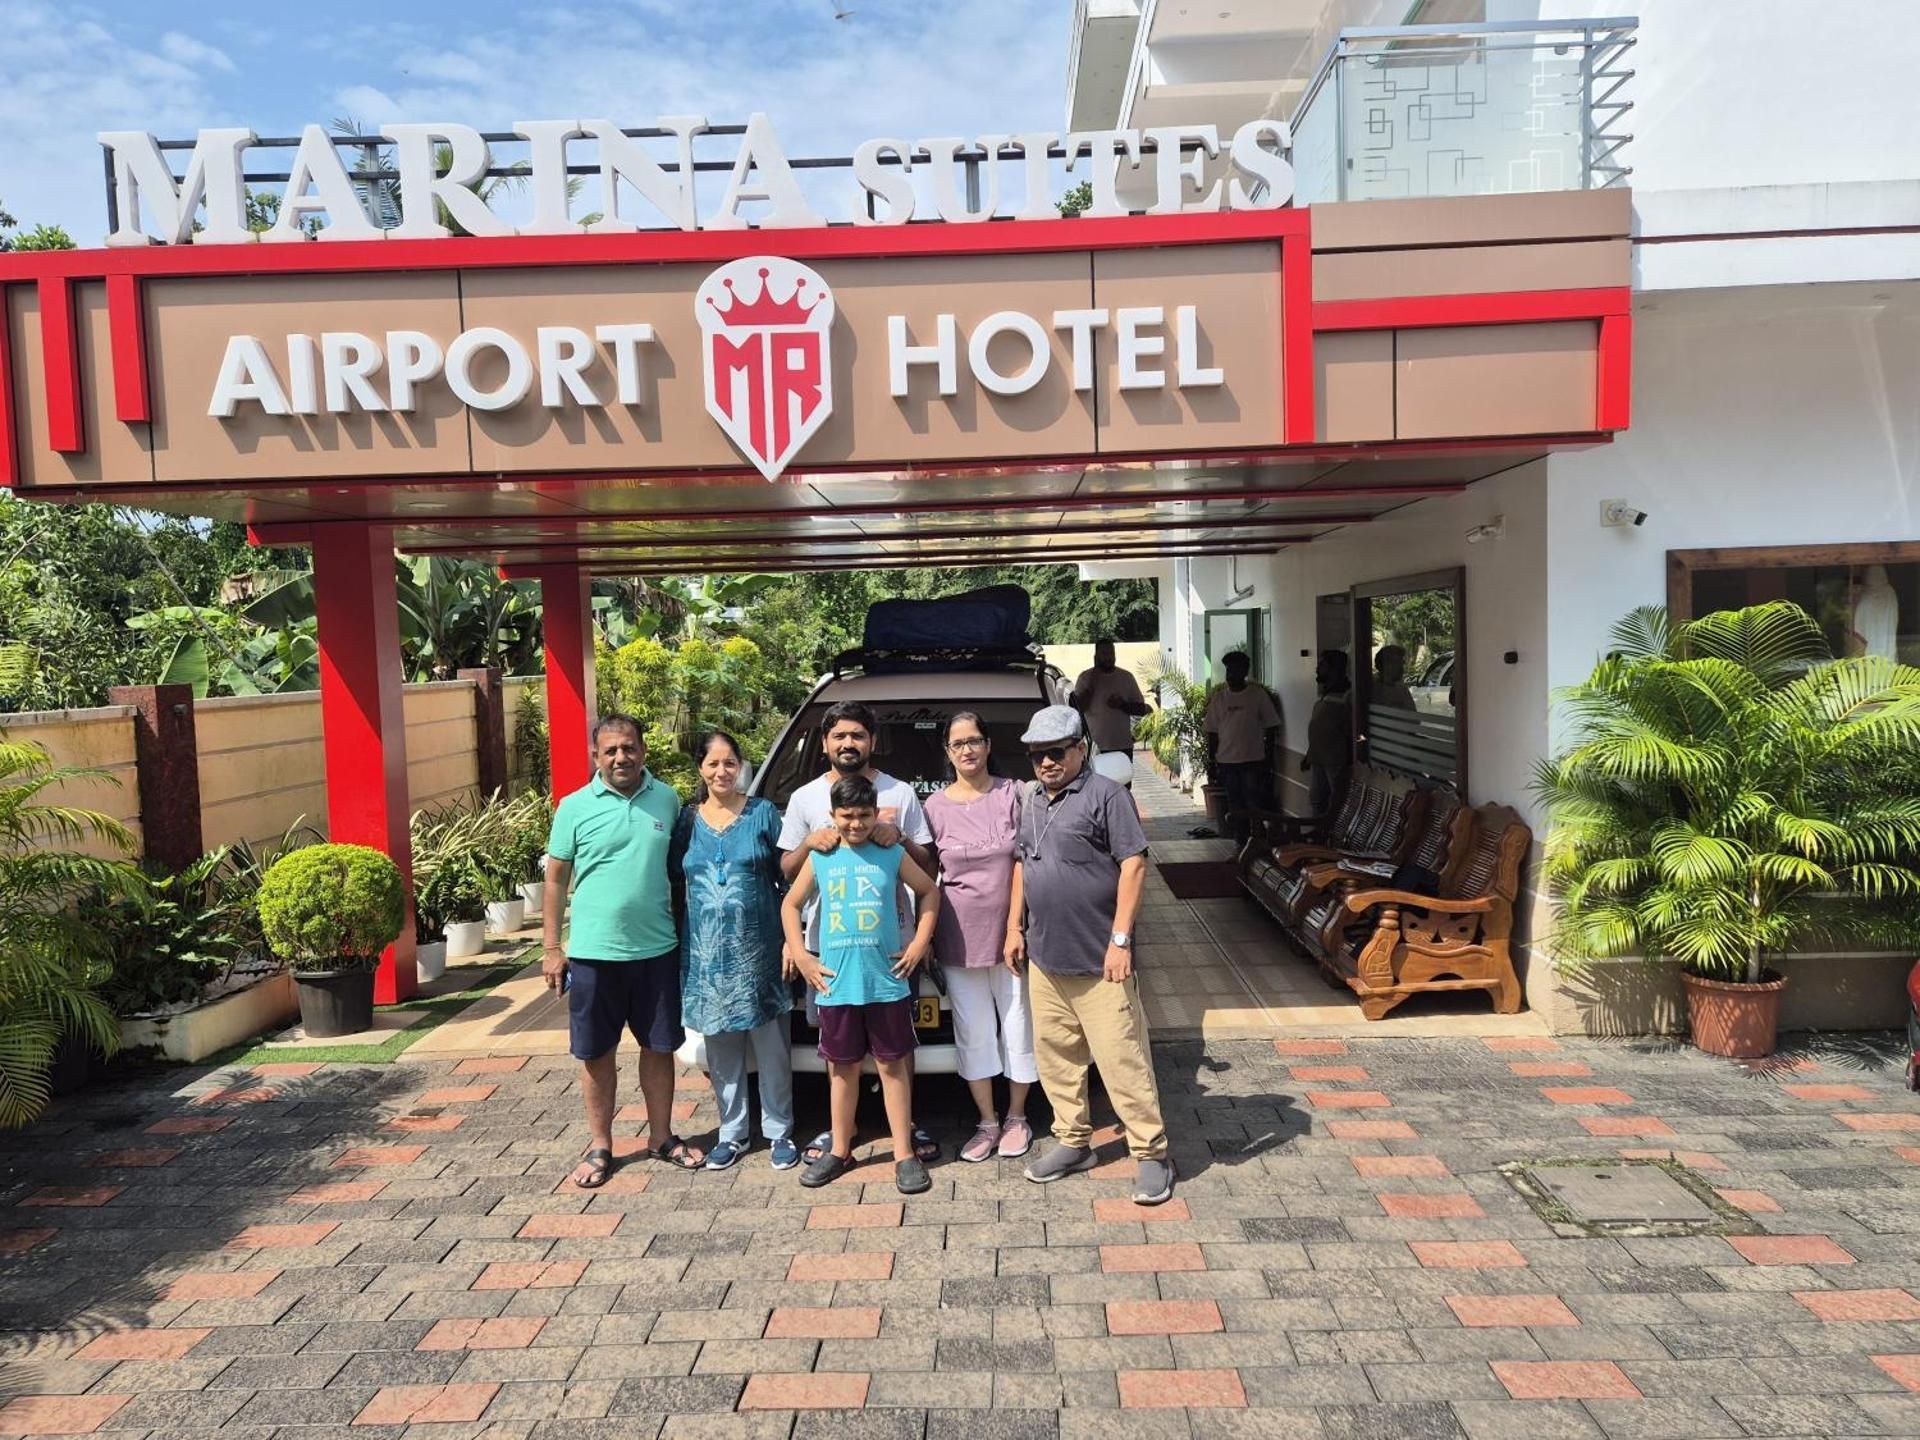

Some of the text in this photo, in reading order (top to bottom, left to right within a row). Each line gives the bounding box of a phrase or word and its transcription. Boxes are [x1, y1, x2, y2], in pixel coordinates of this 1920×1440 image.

[98, 112, 1295, 246] MARINA SUITES
[208, 305, 1225, 418] AIRPORT HOTEL
